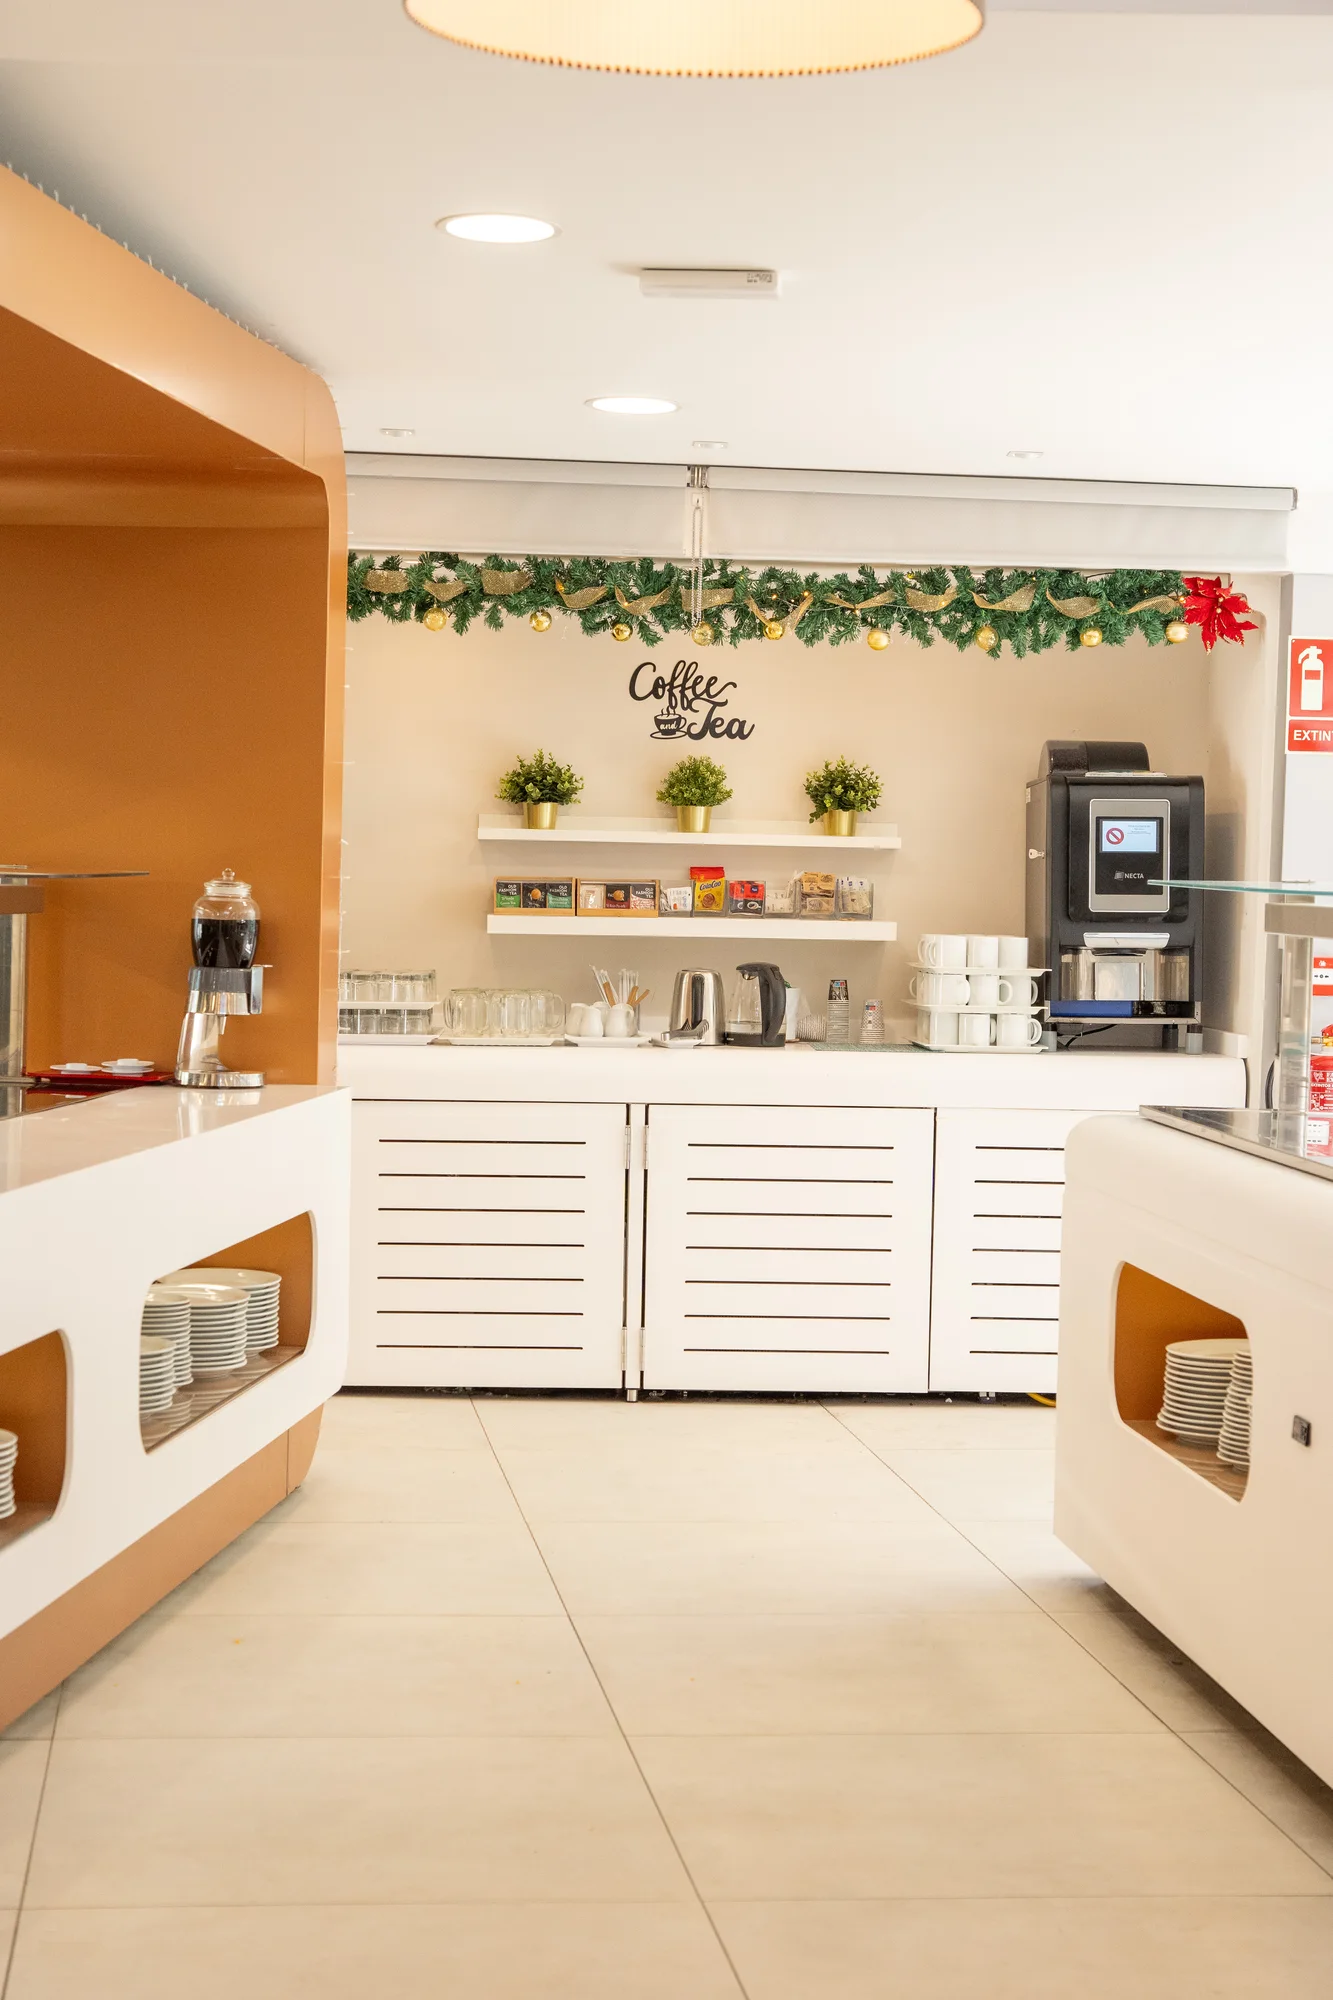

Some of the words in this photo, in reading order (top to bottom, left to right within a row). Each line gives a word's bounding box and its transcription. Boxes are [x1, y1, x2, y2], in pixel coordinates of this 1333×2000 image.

[629, 660, 737, 711] Coffee
[659, 721, 678, 730] and
[687, 697, 755, 741] Tea
[1293, 729, 1333, 741] EXTIN
